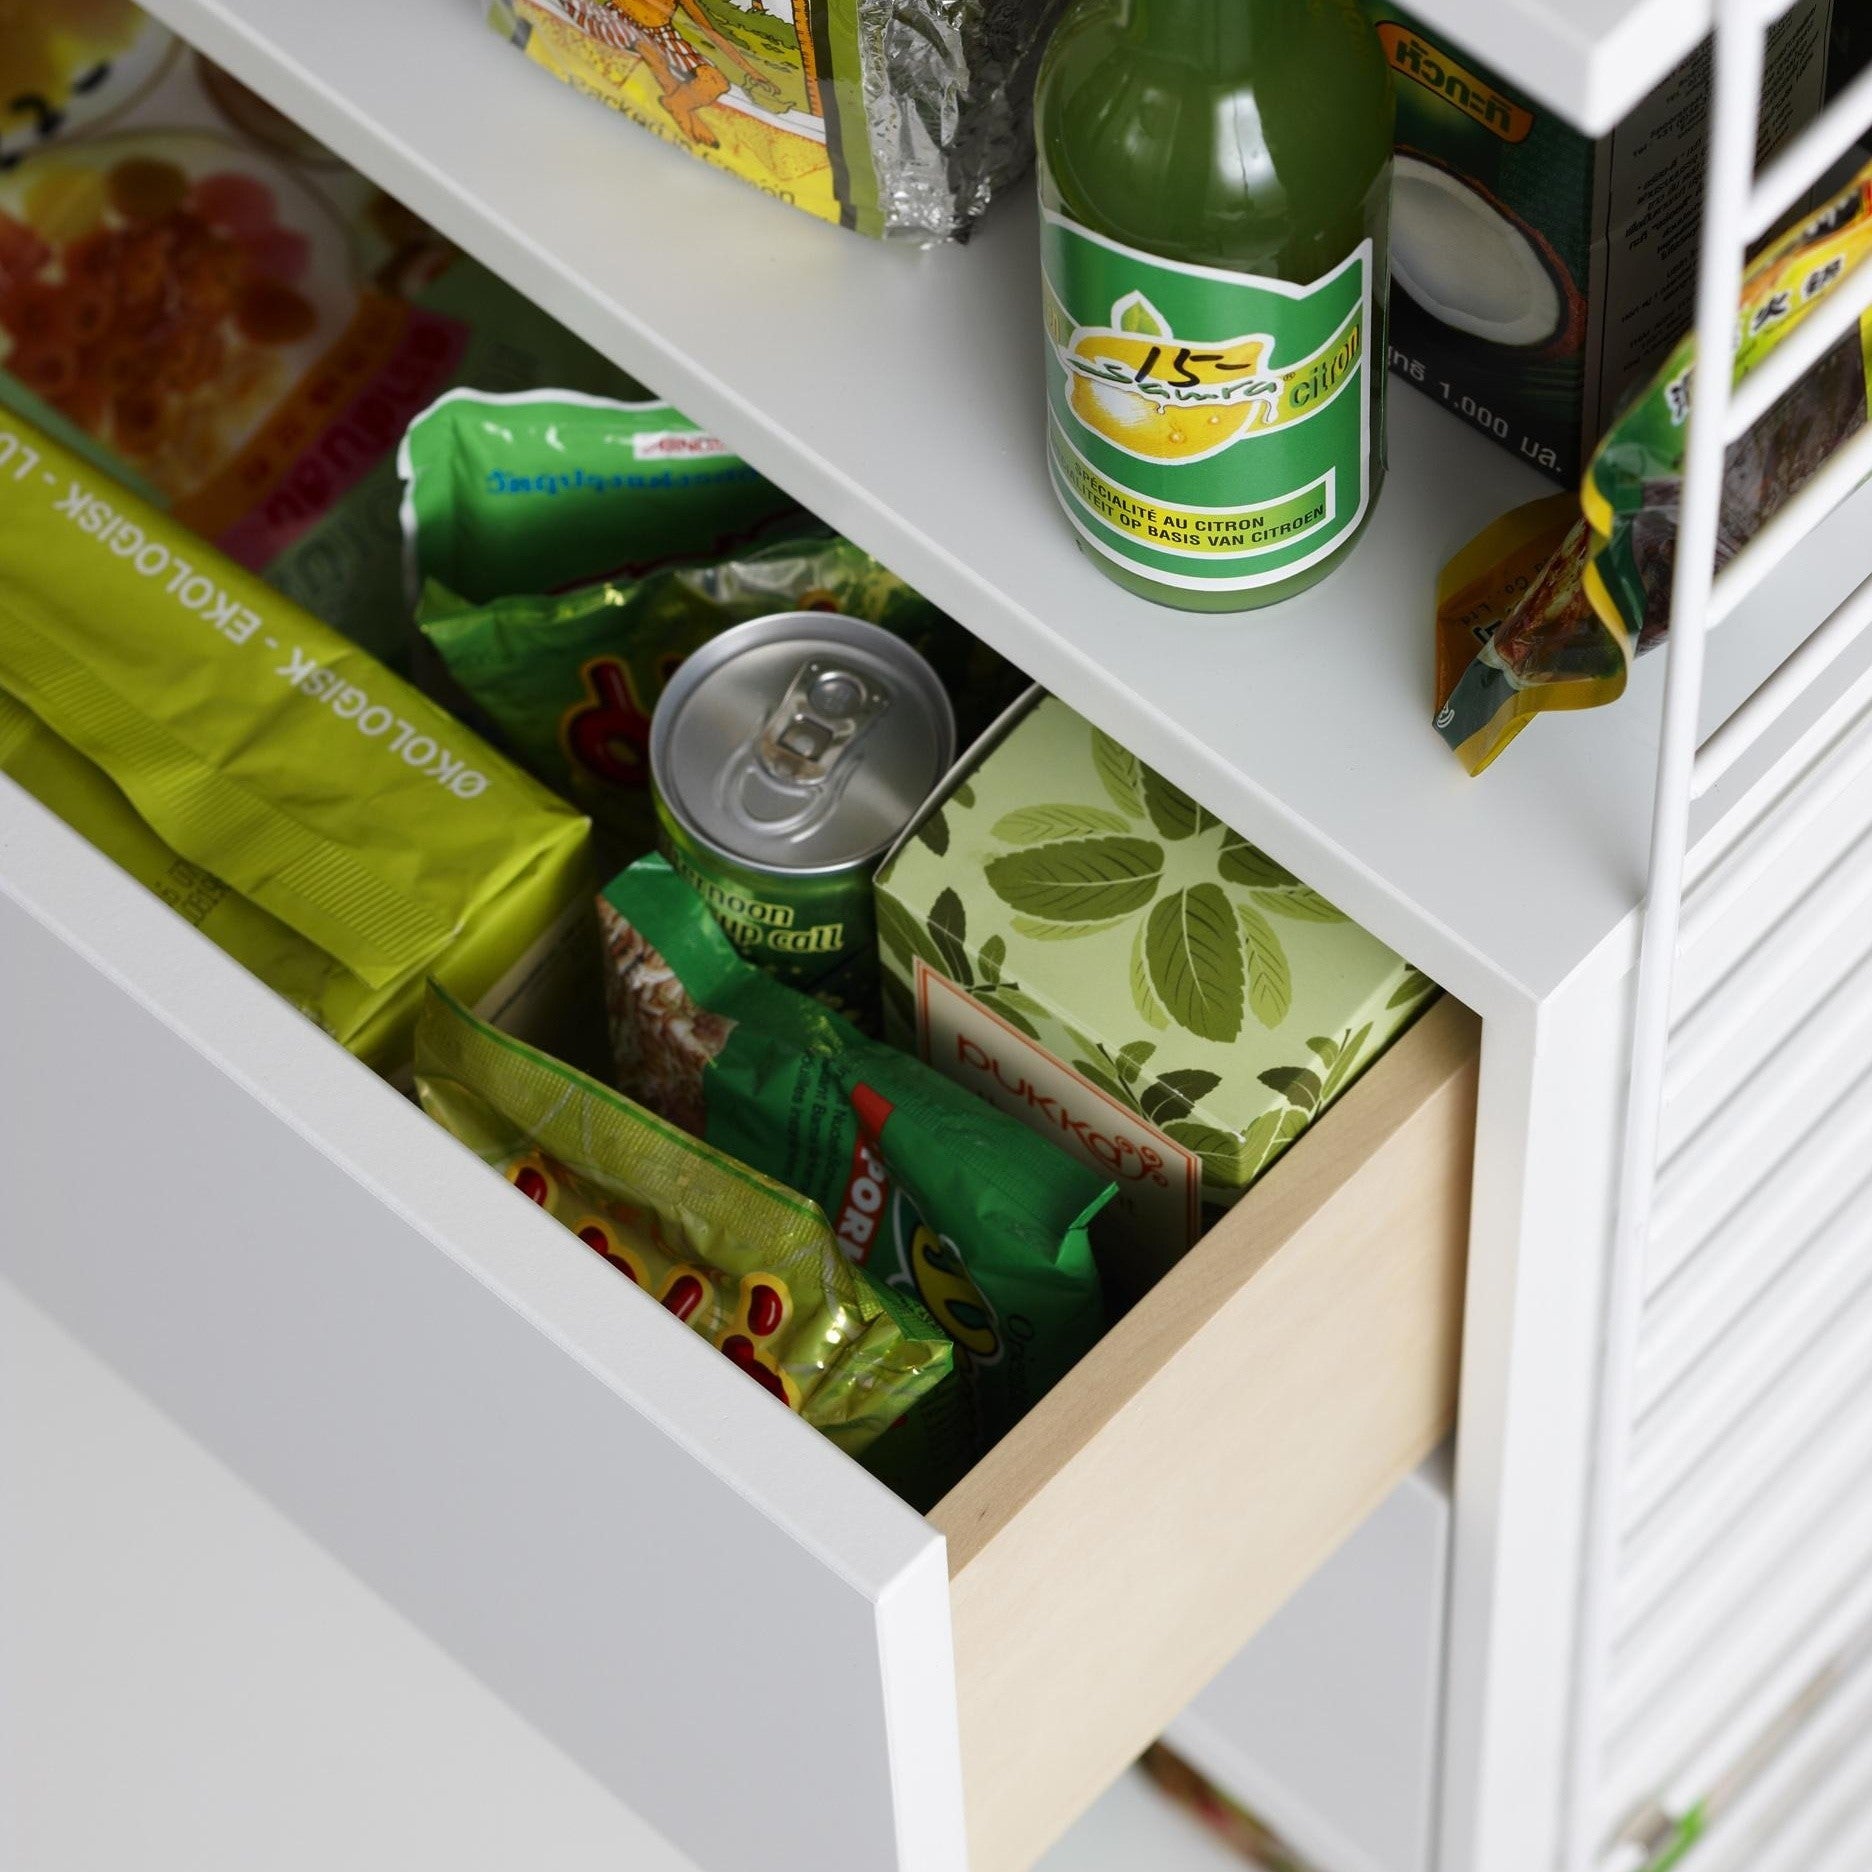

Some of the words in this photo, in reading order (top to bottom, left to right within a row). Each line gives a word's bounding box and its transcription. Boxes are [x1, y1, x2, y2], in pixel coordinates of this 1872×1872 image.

[1289, 323, 1360, 409] citron
[1073, 461, 1158, 524] SPÉCIALITÉ
[1163, 515, 1188, 530] AU
[1194, 516, 1265, 533] CITRON
[1120, 513, 1142, 530] OP
[1148, 525, 1201, 546] BASIS
[1207, 533, 1244, 547] VAN
[1251, 504, 1324, 543] CITROEN
[53, 481, 263, 646] EKOLOGISK
[274, 646, 491, 799] ØKOLOGISK
[690, 868, 794, 928] noon
[769, 924, 844, 953] call
